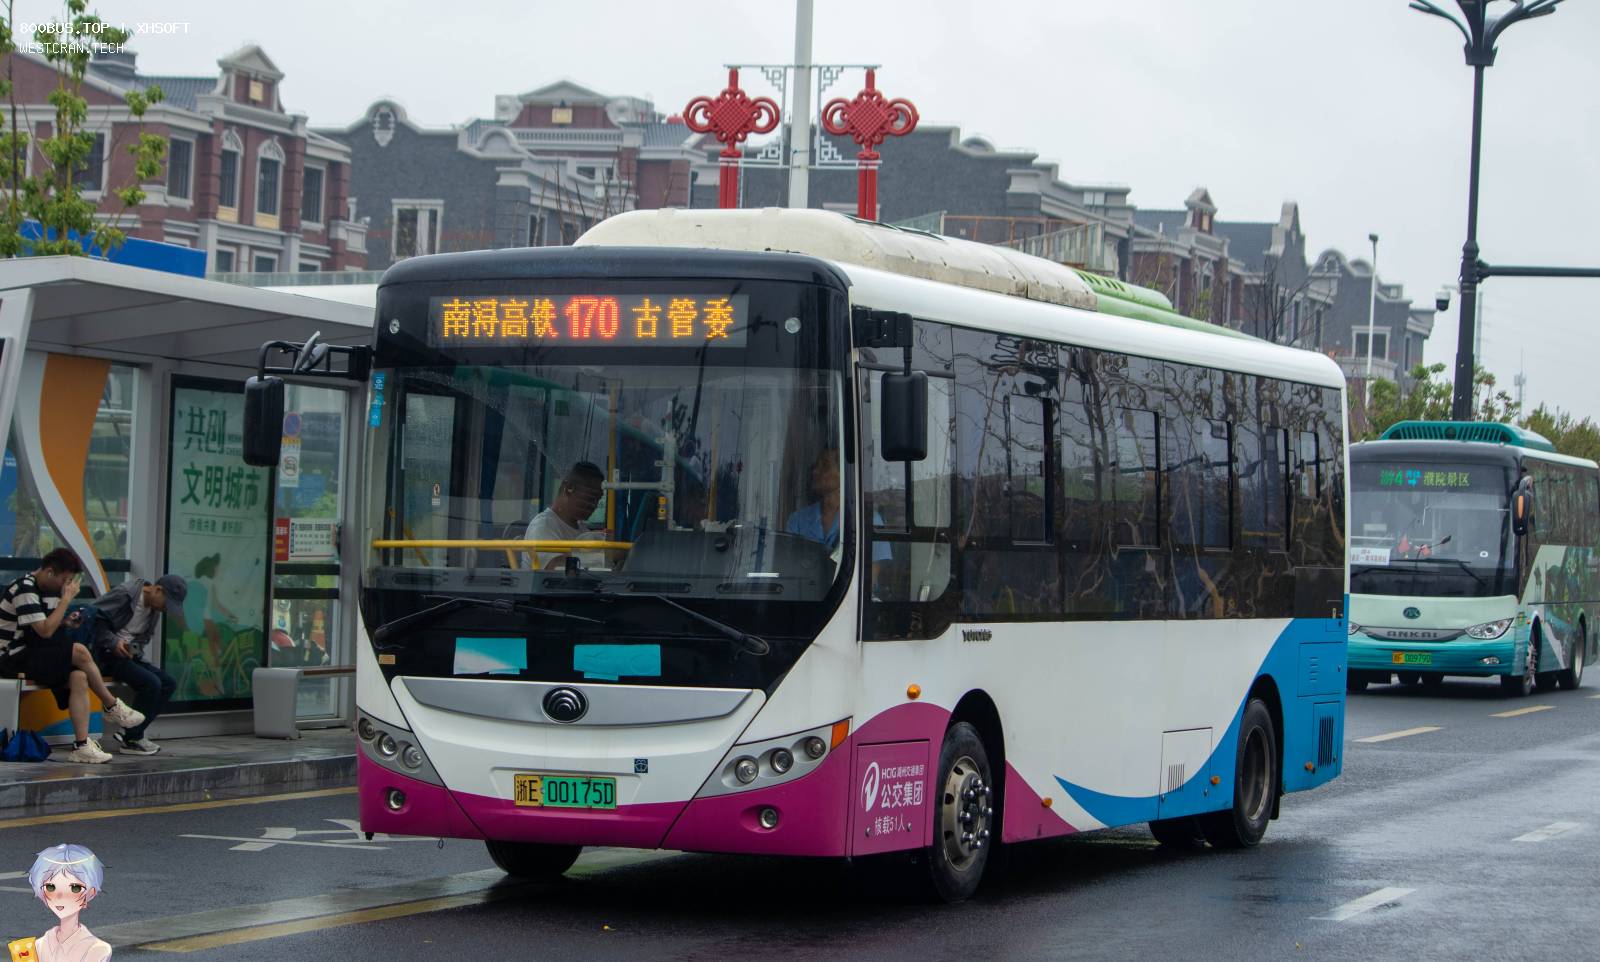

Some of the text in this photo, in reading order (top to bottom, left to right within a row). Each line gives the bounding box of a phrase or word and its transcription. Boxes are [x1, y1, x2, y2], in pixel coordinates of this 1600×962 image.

[442, 297, 734, 338] 南浔高铁 170 古管委
[180, 462, 261, 510] 文明城市
[1387, 630, 1438, 638] ANKAI
[516, 779, 614, 805] 浙E 00175D
[881, 780, 924, 809] 公交集团
[874, 813, 905, 836] 核载51人
